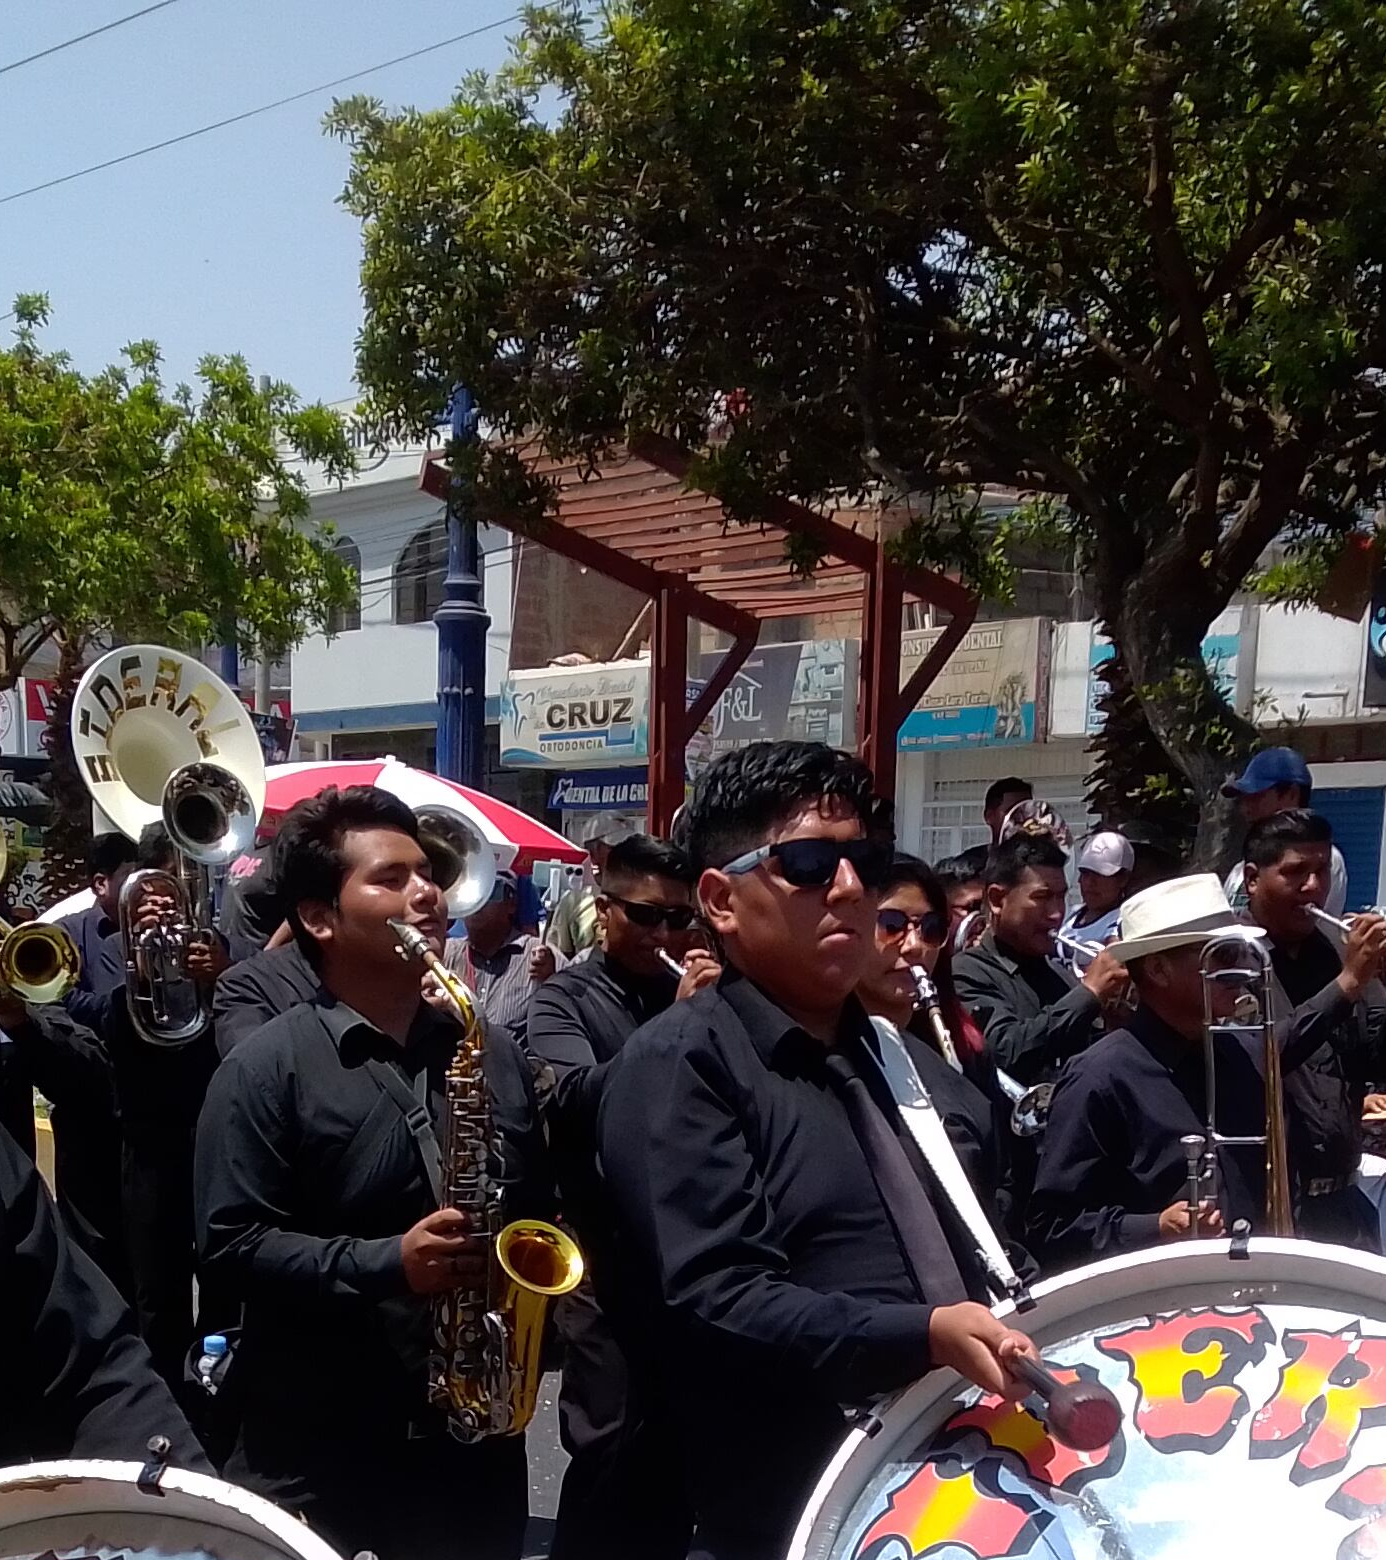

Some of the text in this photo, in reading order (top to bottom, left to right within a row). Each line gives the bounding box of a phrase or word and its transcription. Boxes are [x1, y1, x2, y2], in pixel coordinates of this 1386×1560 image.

[963, 629, 1004, 651] DENTAL
[546, 697, 634, 730] CRUZ
[539, 739, 603, 754] ORTODONCIA
